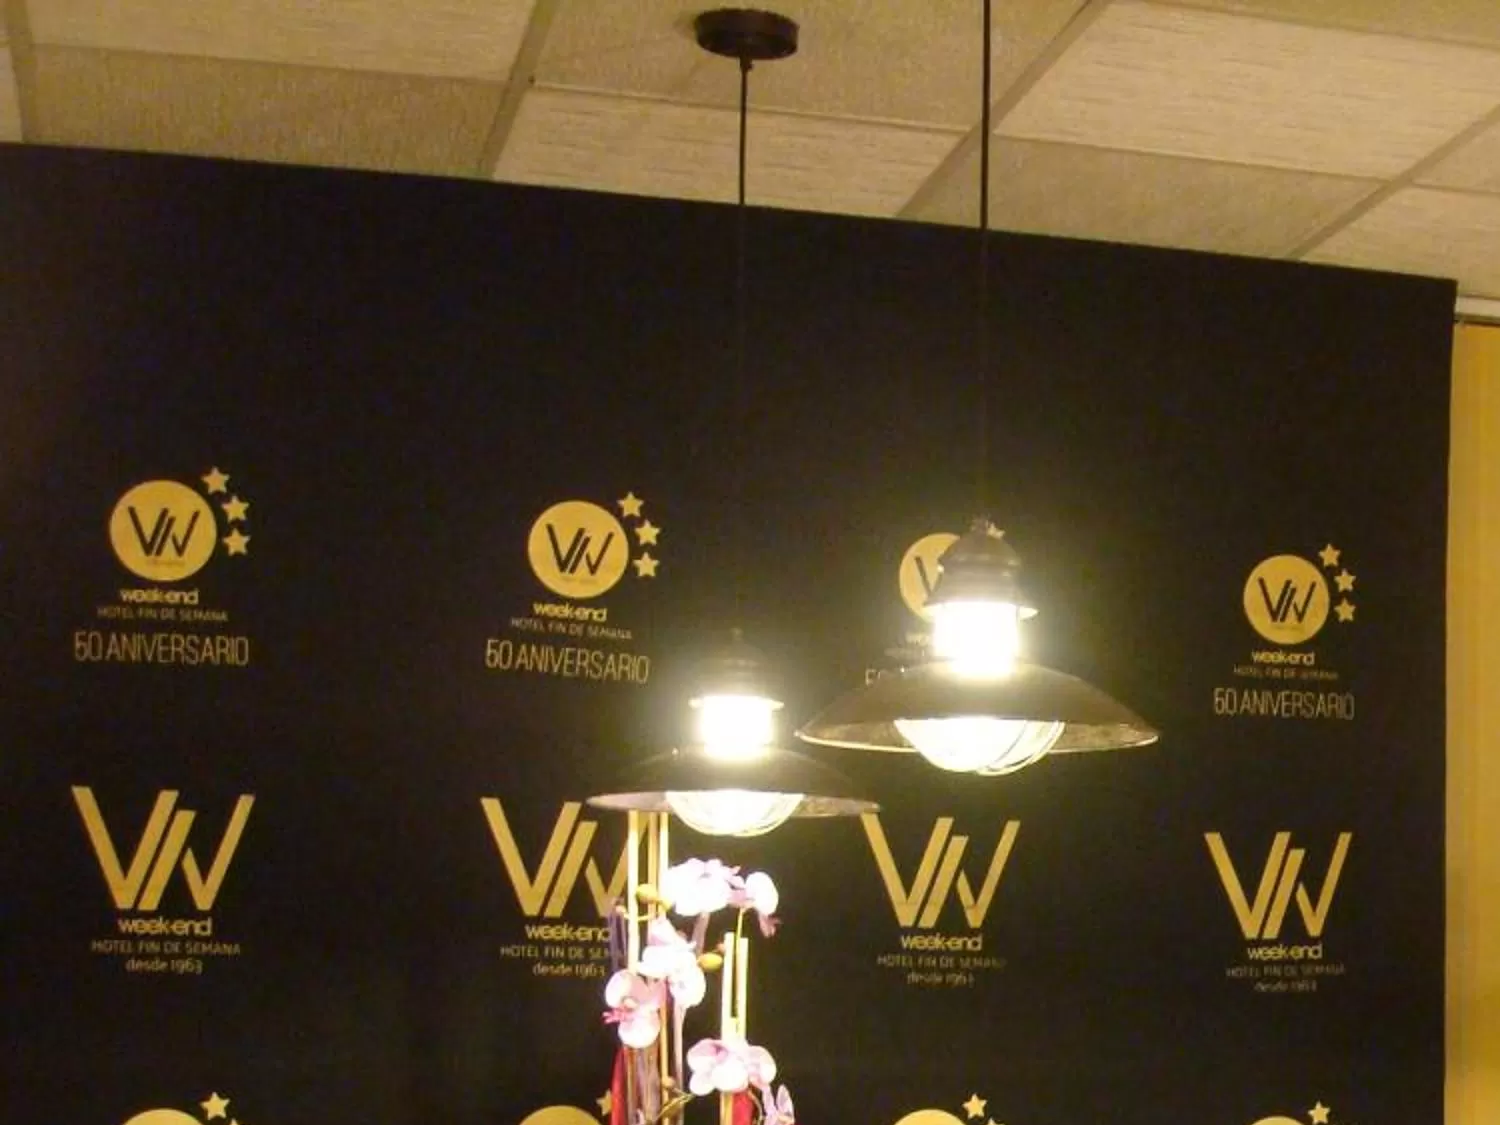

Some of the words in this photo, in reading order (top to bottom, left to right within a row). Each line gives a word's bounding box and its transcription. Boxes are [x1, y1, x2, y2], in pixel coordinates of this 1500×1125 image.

[105, 633, 249, 666] ANIVERSARIO
[516, 643, 649, 684] ANIVERSARIO
[1240, 689, 1355, 720] ANIVERSARIO
